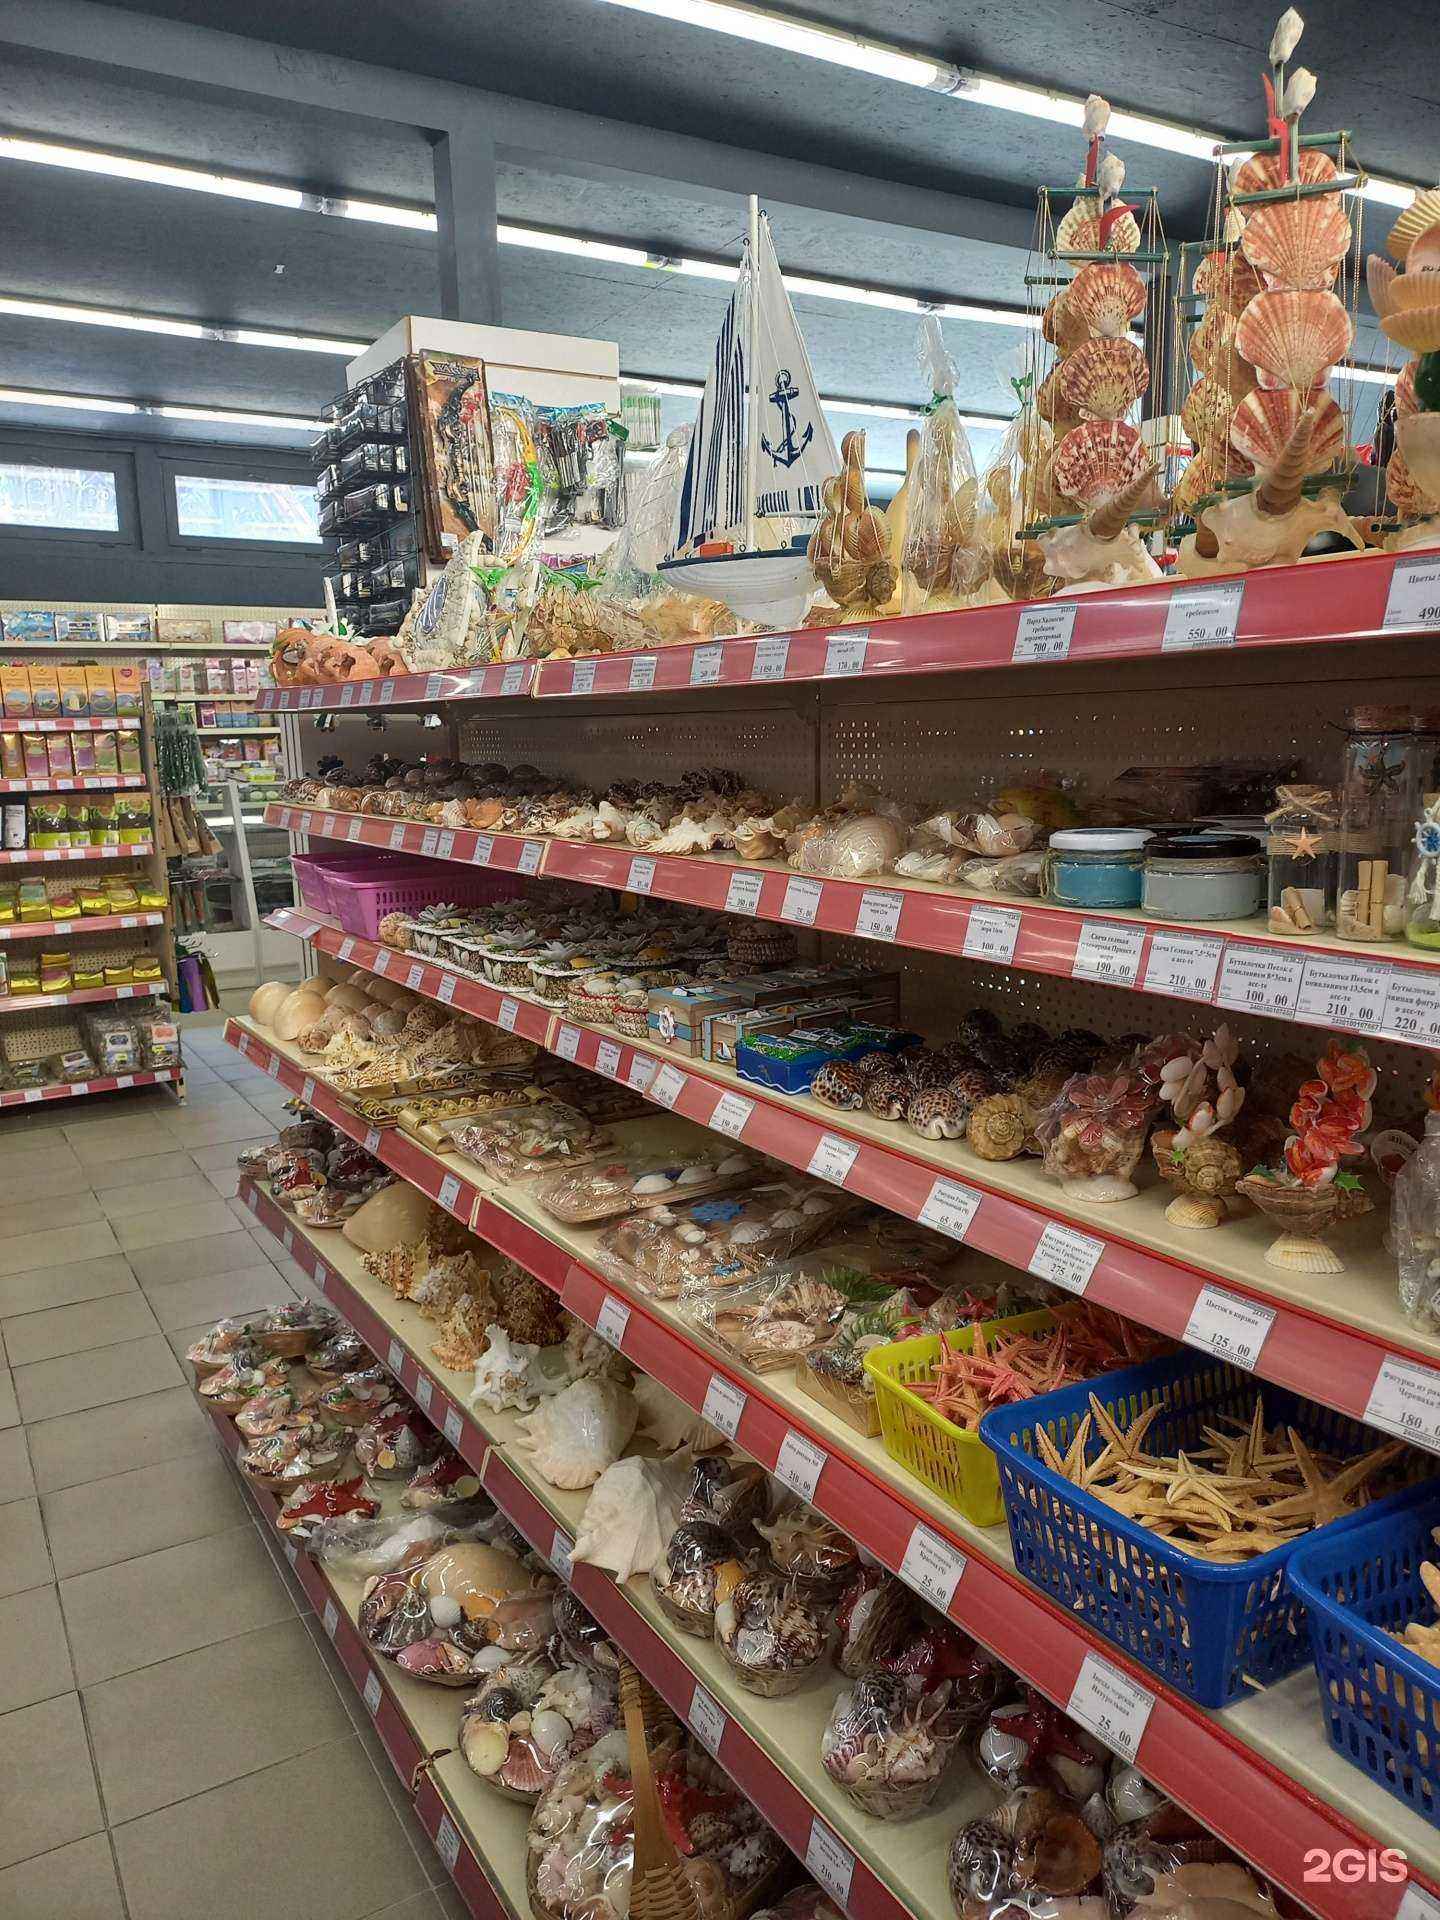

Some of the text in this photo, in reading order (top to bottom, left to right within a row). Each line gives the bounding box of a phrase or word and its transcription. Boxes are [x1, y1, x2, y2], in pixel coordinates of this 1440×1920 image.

[1188, 628, 1206, 640] 550
[1033, 642, 1047, 653] 700
[1095, 961, 1112, 973] 190
[1229, 958, 1266, 970] Бутылочка
[1266, 962, 1289, 972] Песок
[1169, 973, 1186, 986] 210
[1309, 969, 1349, 981] Бутылочка
[1350, 974, 1373, 984] Песок
[1245, 989, 1264, 1003] 100
[1326, 1002, 1348, 1016] 210
[1394, 1016, 1418, 1031] 220
[1210, 1332, 1230, 1348] 125
[1400, 1411, 1422, 1429] 180
[922, 1574, 933, 1588] 25
[1098, 1714, 1112, 1731] 25
